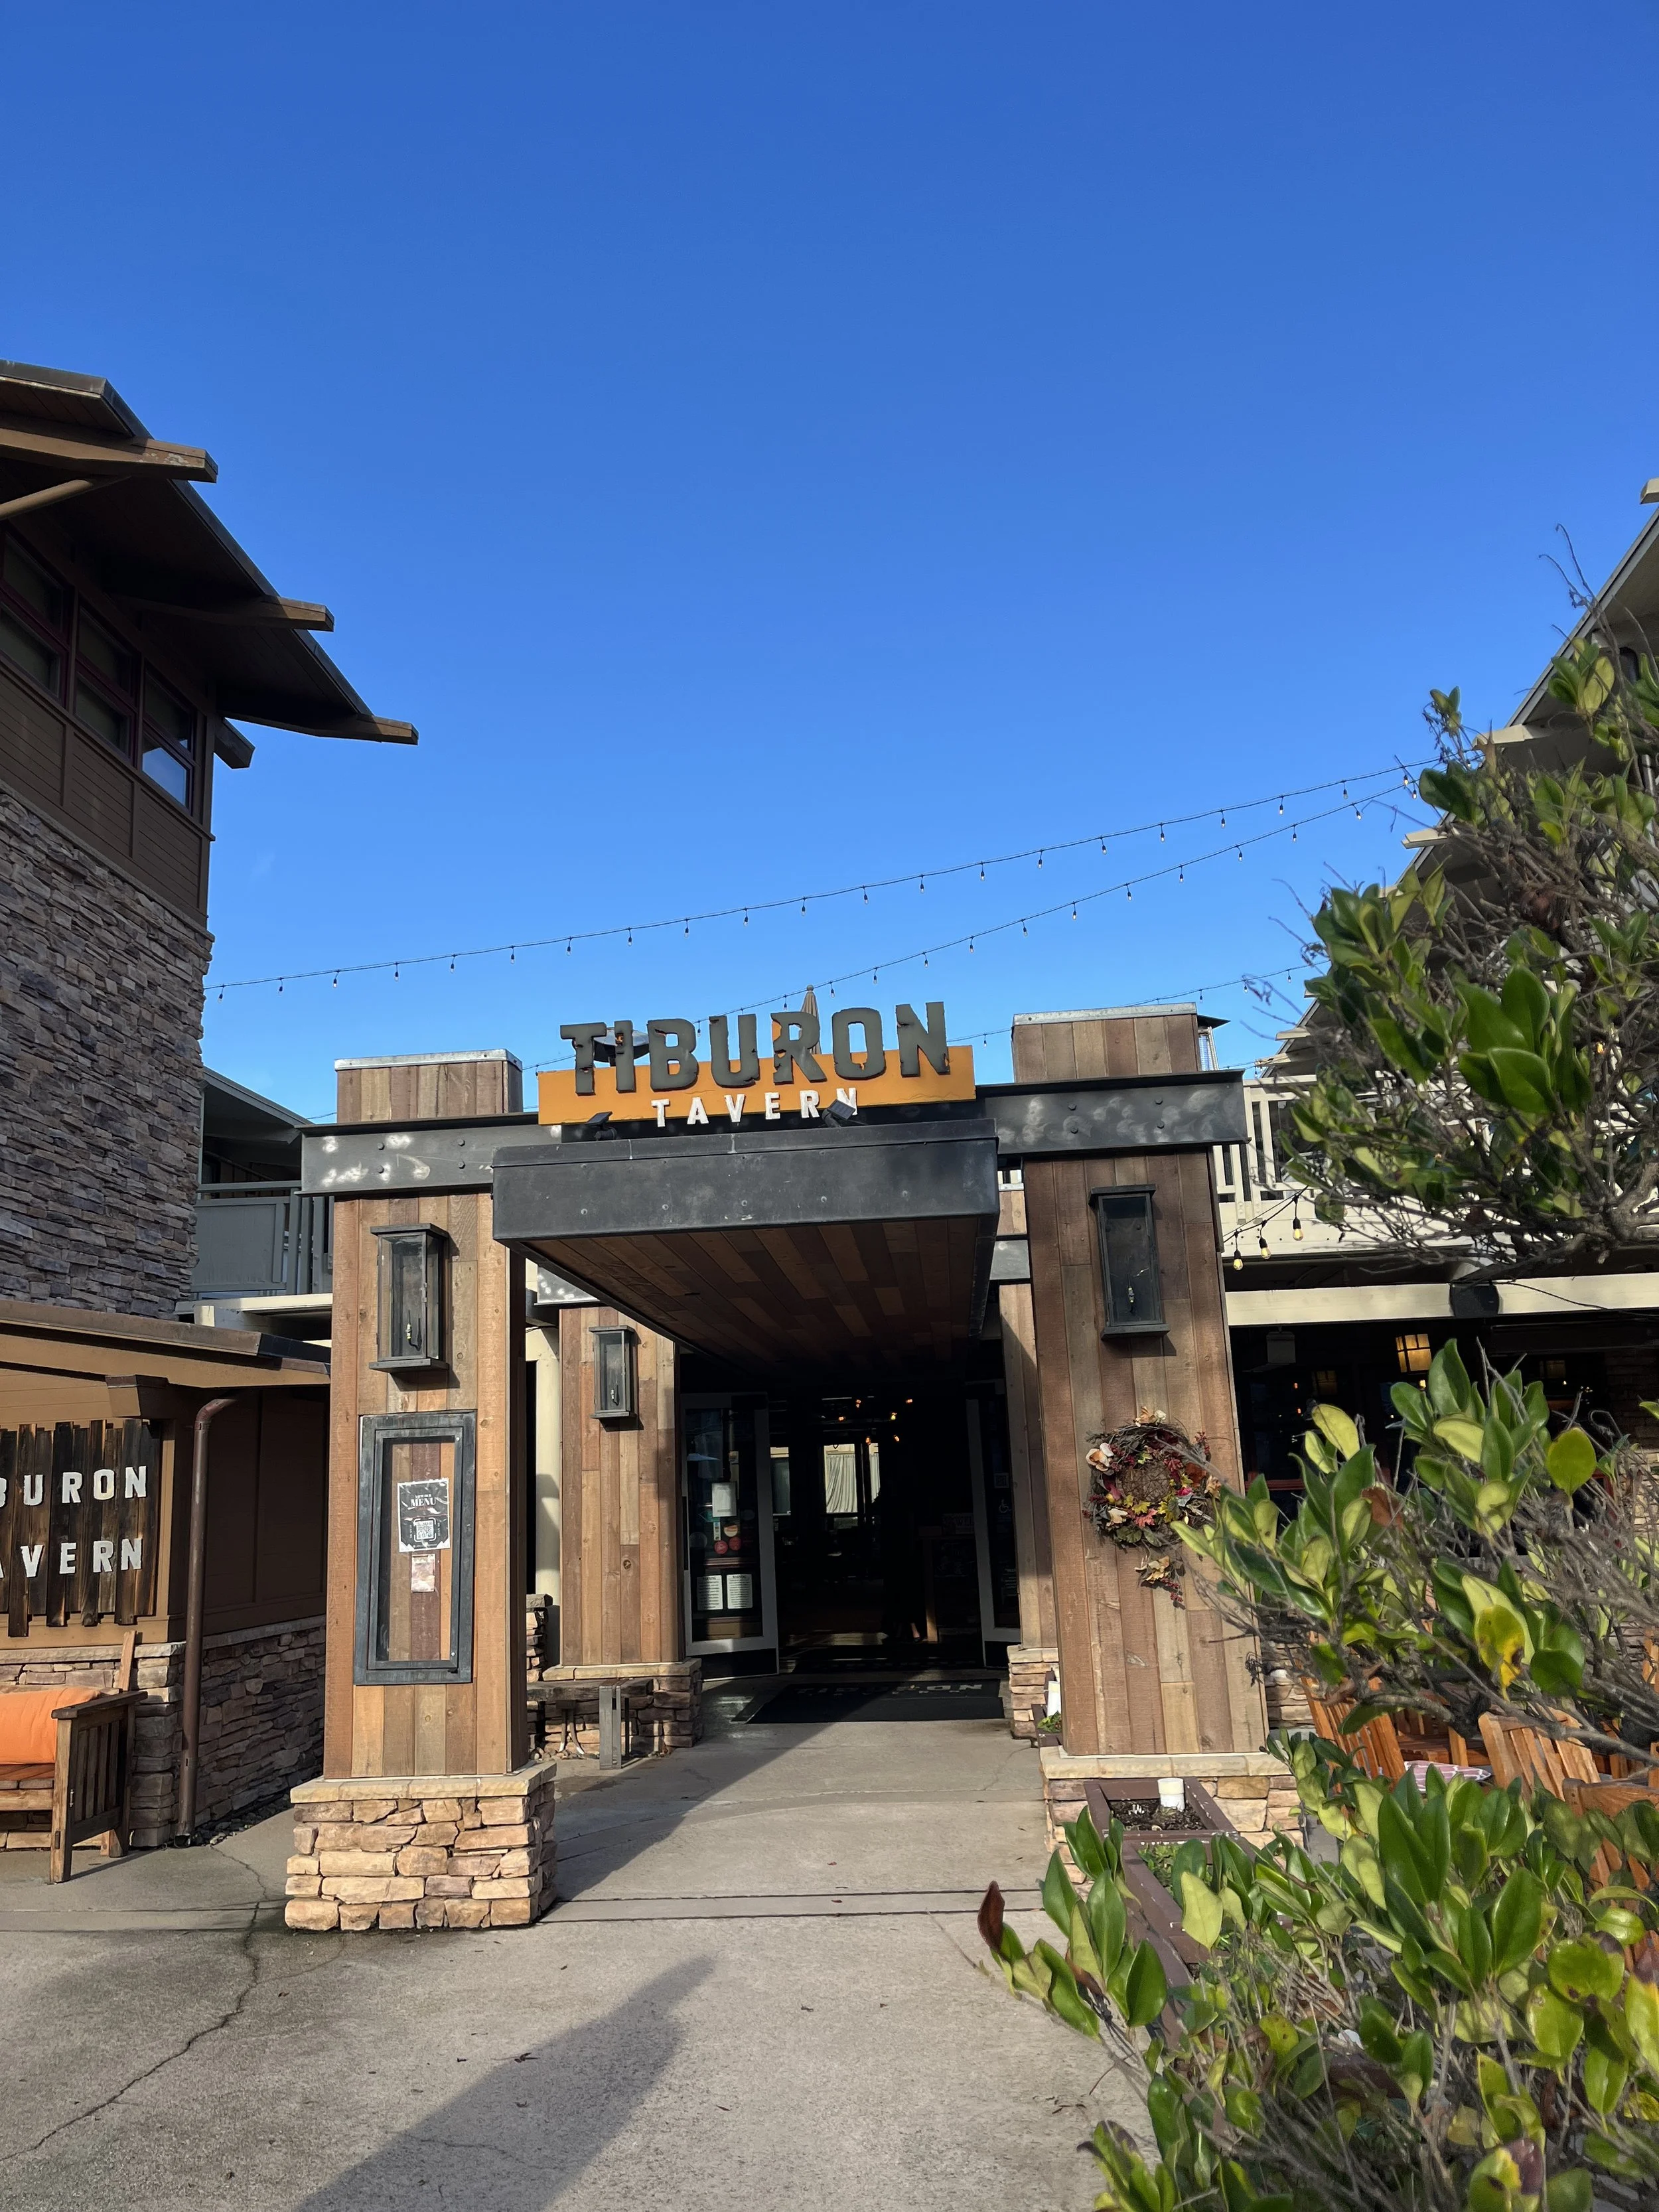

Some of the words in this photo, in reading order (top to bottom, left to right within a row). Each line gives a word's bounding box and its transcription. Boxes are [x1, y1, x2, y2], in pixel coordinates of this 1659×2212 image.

[560, 1001, 950, 1096] TIBURON
[651, 1087, 858, 1127] TAVERN
[410, 1497, 437, 1507] MENU
[0, 1538, 143, 1578] VERN
